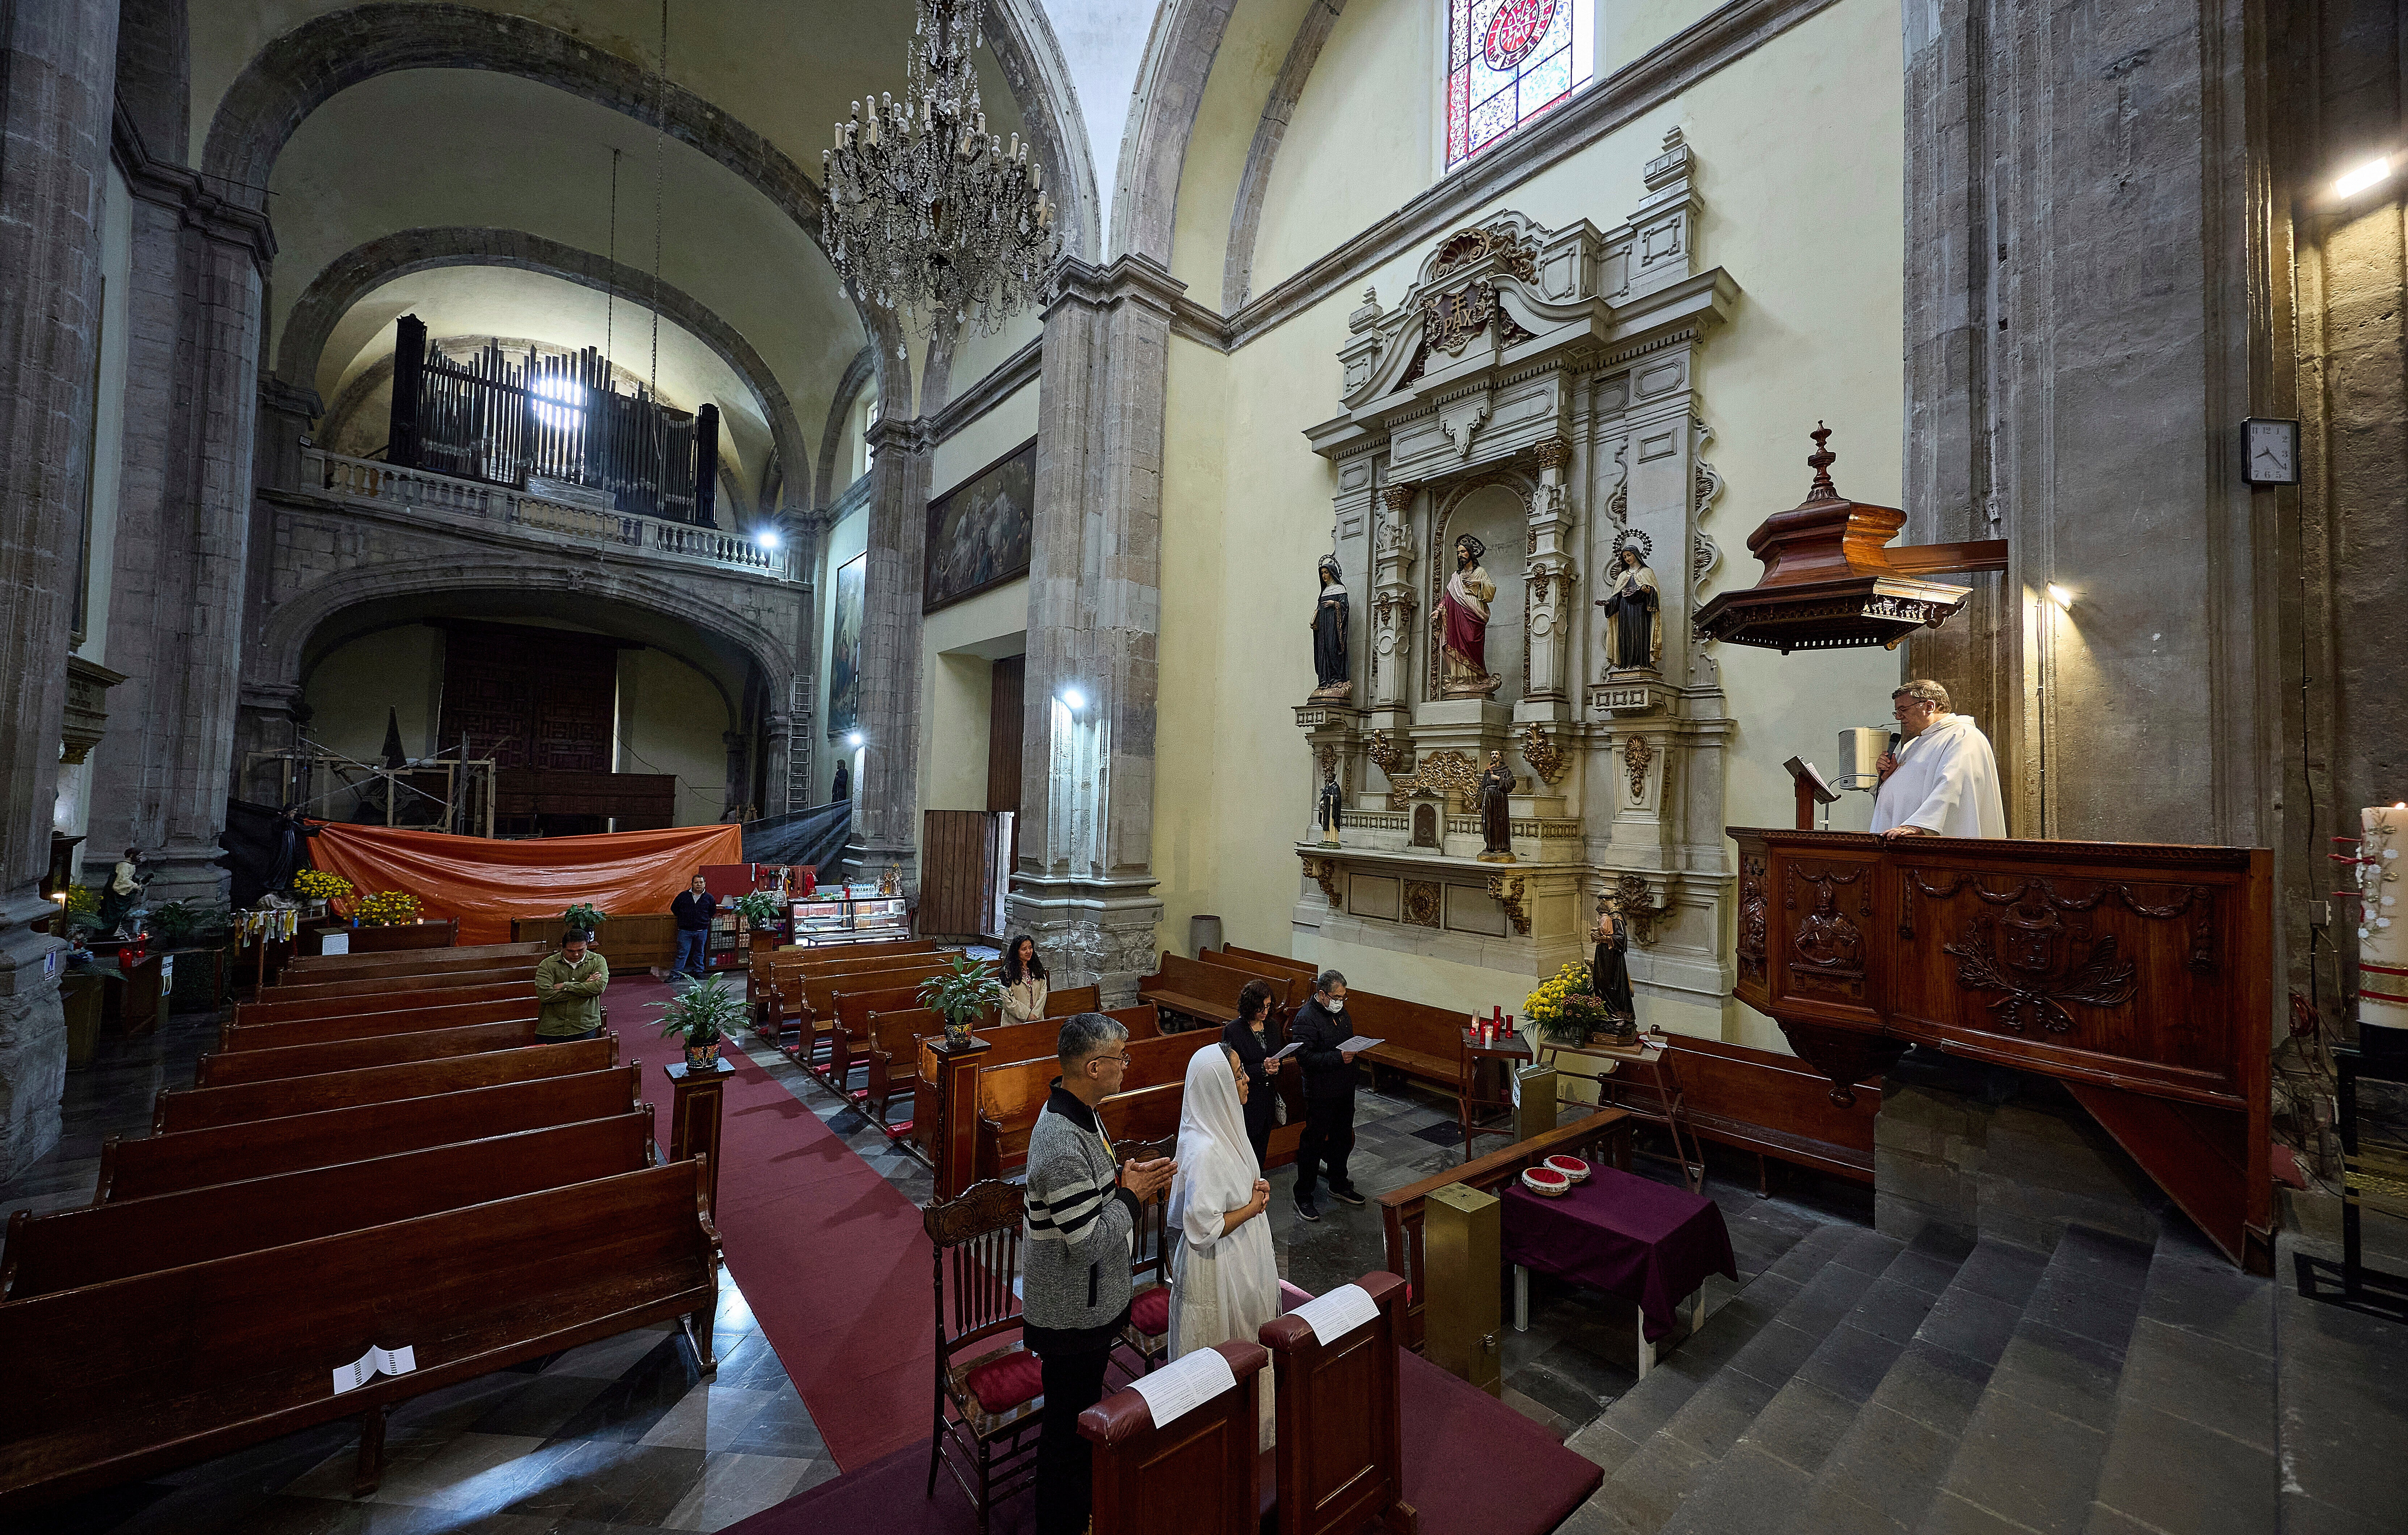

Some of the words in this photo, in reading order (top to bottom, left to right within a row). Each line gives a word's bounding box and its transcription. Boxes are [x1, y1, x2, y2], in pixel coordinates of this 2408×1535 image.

[1444, 309, 1474, 336] PAX
[354, 1361, 363, 1385] RESERVADO
[388, 1352, 397, 1374] RESERVADO
